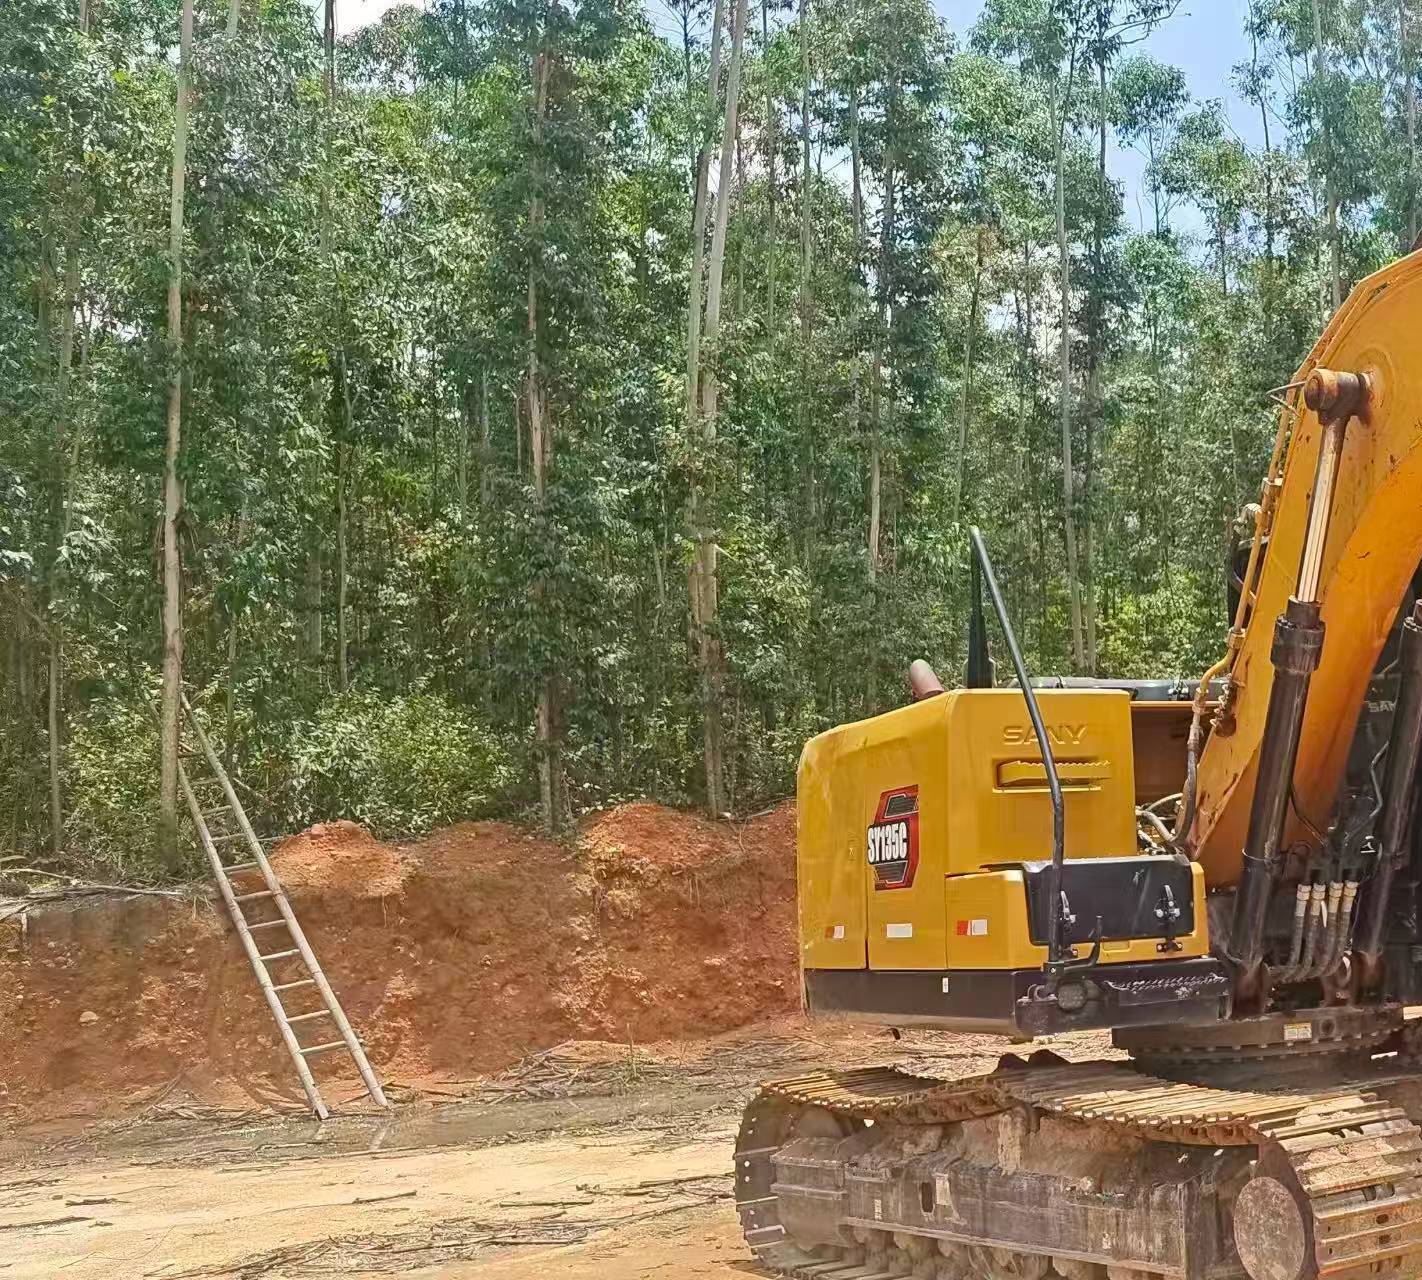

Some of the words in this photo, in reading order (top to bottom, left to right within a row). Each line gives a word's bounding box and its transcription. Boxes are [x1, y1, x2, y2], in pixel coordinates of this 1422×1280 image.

[1368, 701, 1396, 713] SAN
[1003, 725, 1088, 745] SANY
[867, 821, 908, 863] SY135C
